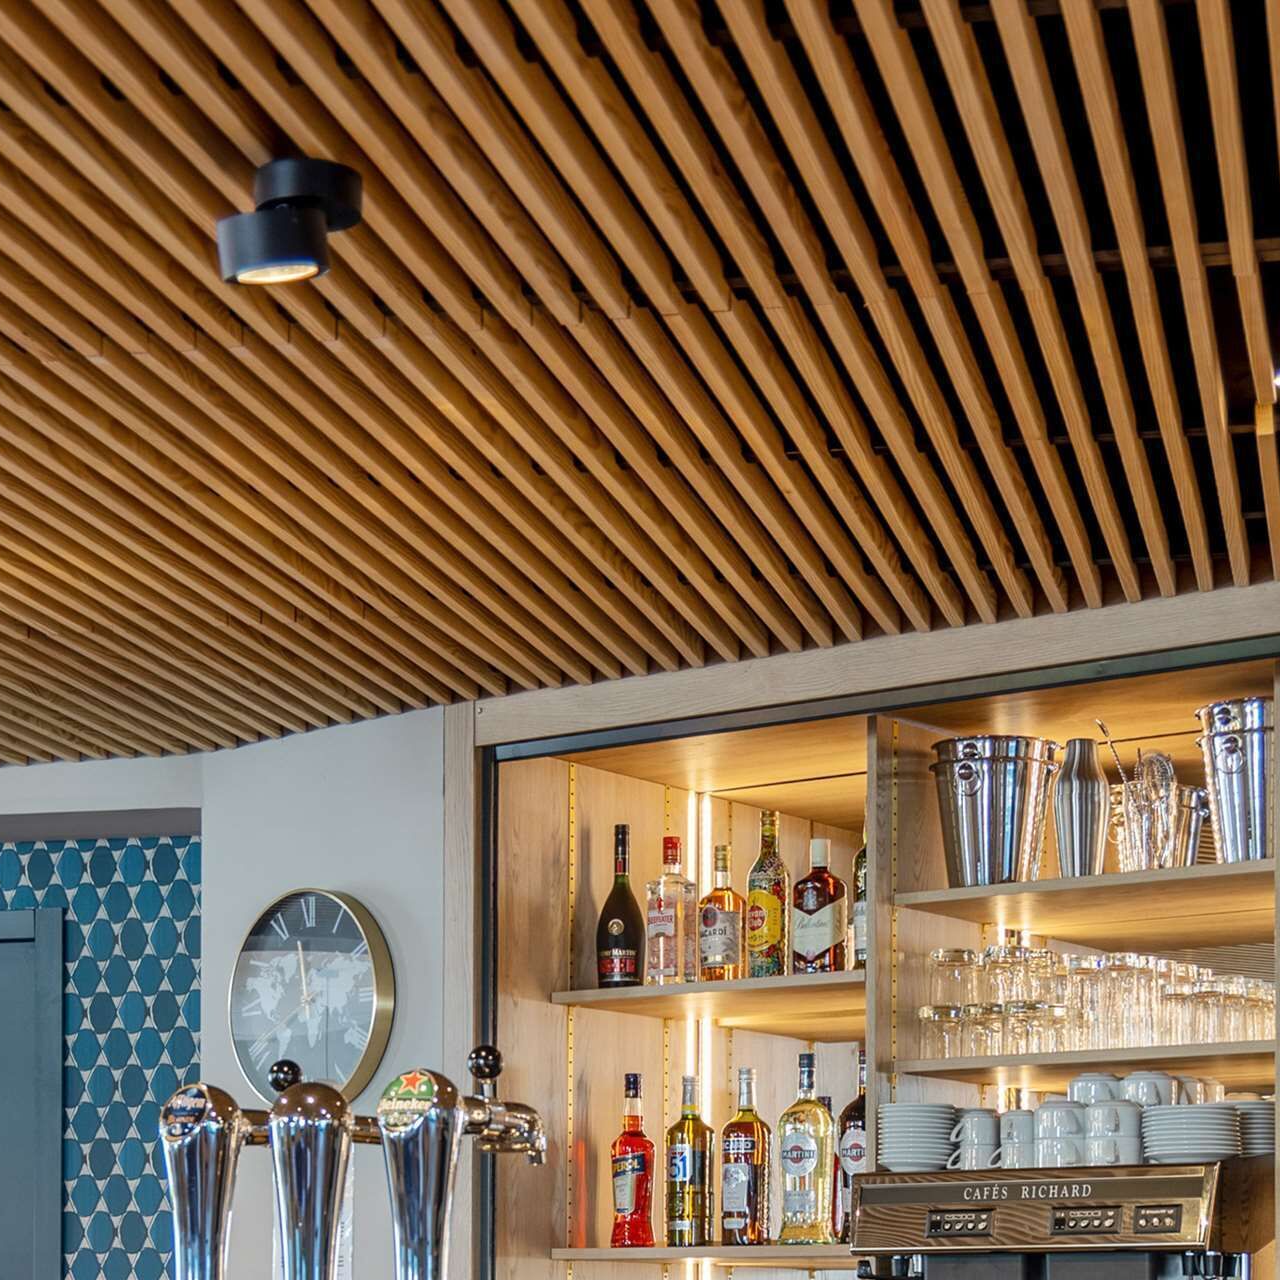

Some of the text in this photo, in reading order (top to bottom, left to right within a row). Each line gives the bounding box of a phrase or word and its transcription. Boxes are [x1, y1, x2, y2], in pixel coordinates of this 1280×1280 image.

[782, 1149, 816, 1160] MARTINI
[963, 1183, 1092, 1201] CAFÉS RICHARD
